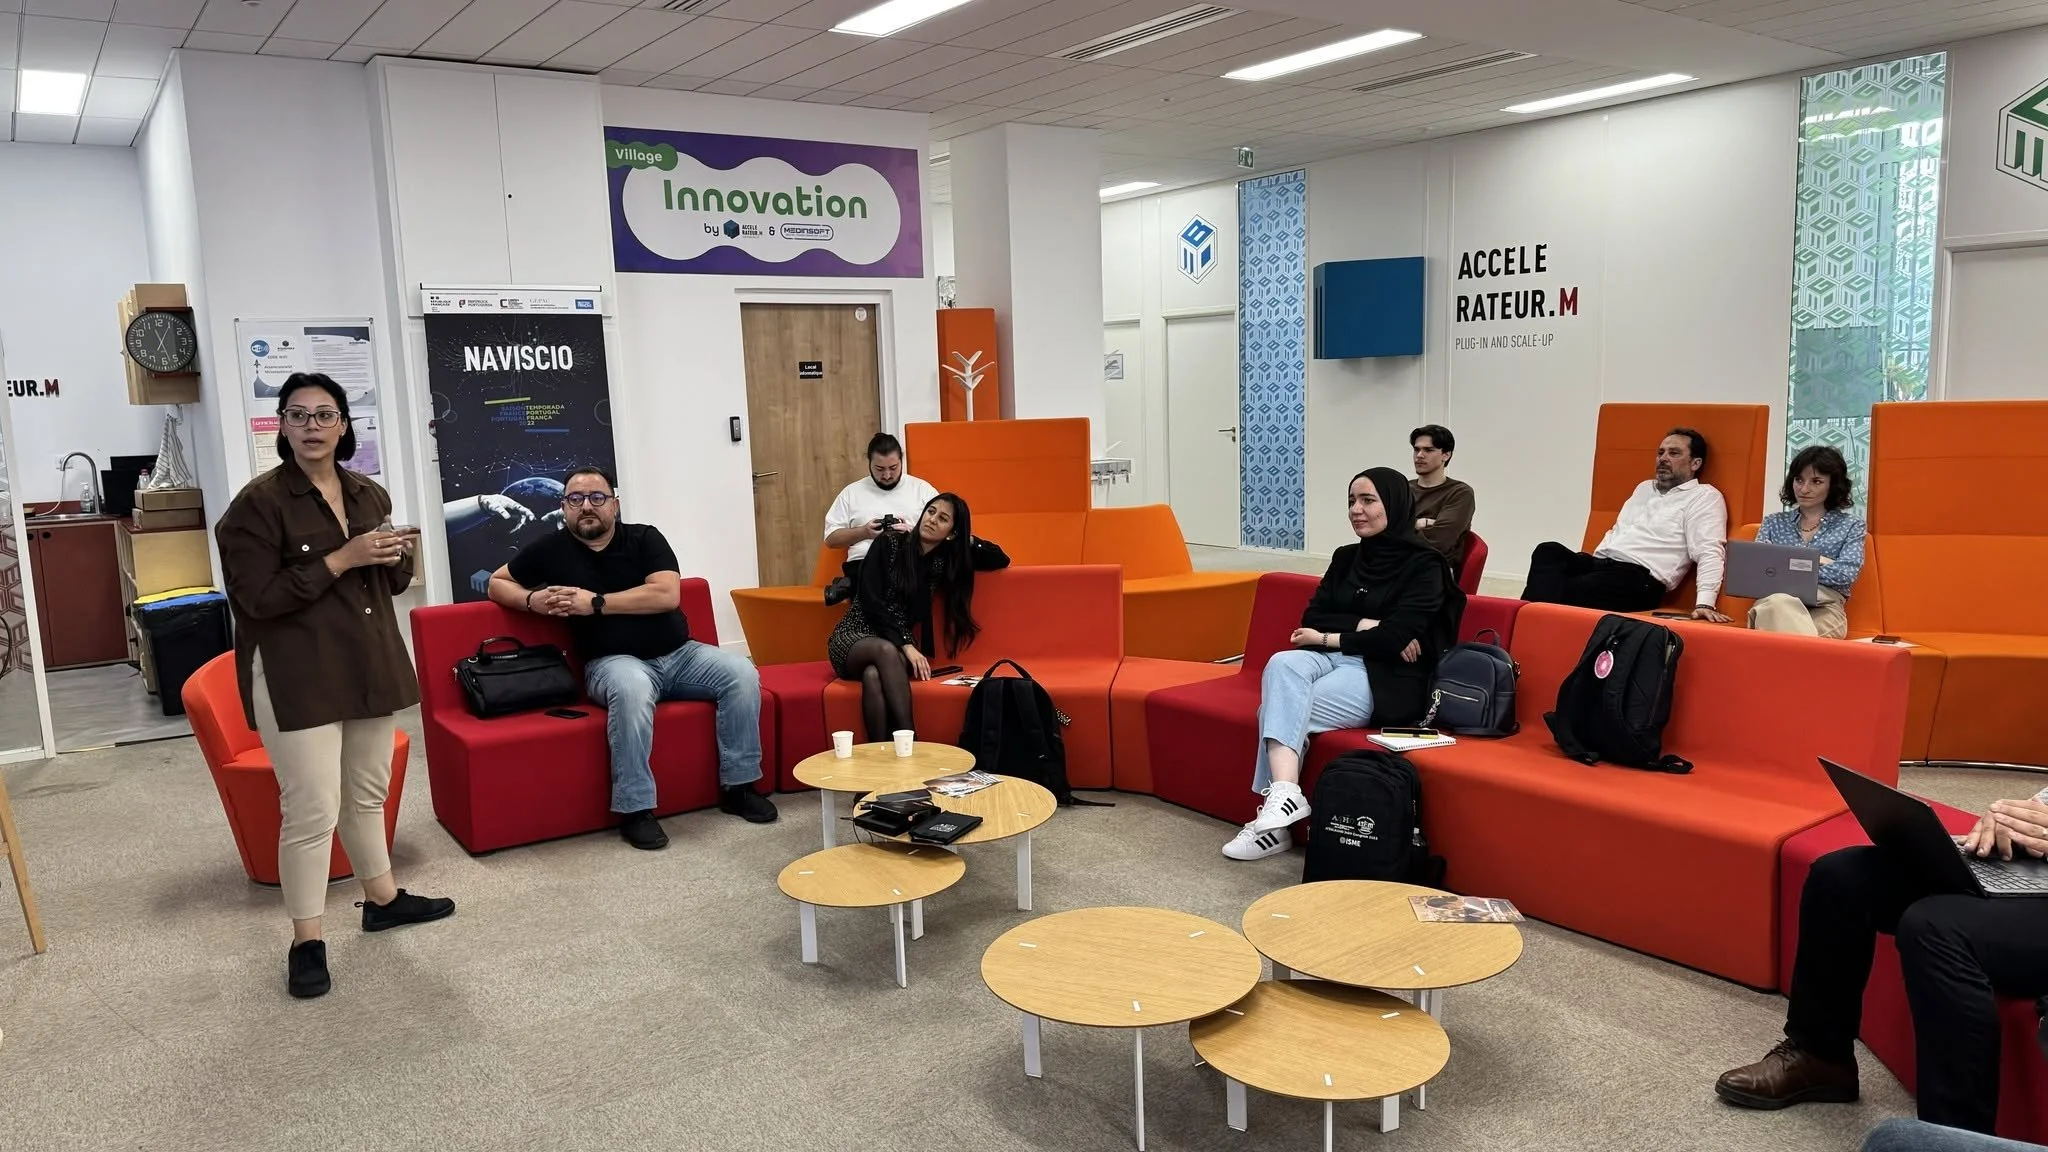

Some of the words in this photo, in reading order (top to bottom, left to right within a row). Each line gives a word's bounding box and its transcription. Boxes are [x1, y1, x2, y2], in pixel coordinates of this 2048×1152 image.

[615, 148, 663, 165] Village
[663, 179, 868, 219] Innovation
[704, 223, 720, 237] by
[769, 226, 776, 236] &
[784, 227, 831, 235] MEDINSOFT
[1458, 243, 1548, 280] ACCELE
[1456, 286, 1579, 323] RATEUR.M
[154, 319, 163, 327] 12
[135, 329, 145, 337] 10
[176, 327, 183, 336] 2
[135, 339, 142, 348] 9
[181, 337, 188, 346] 3
[1455, 336, 1489, 350] PLUG-IN
[1491, 335, 1508, 349] AND
[1511, 333, 1554, 348] SCALE-UP
[140, 349, 147, 357] 8
[149, 355, 156, 363] 7
[161, 357, 168, 366] 6
[172, 354, 179, 362] 5
[464, 345, 573, 372] NAVISCIO
